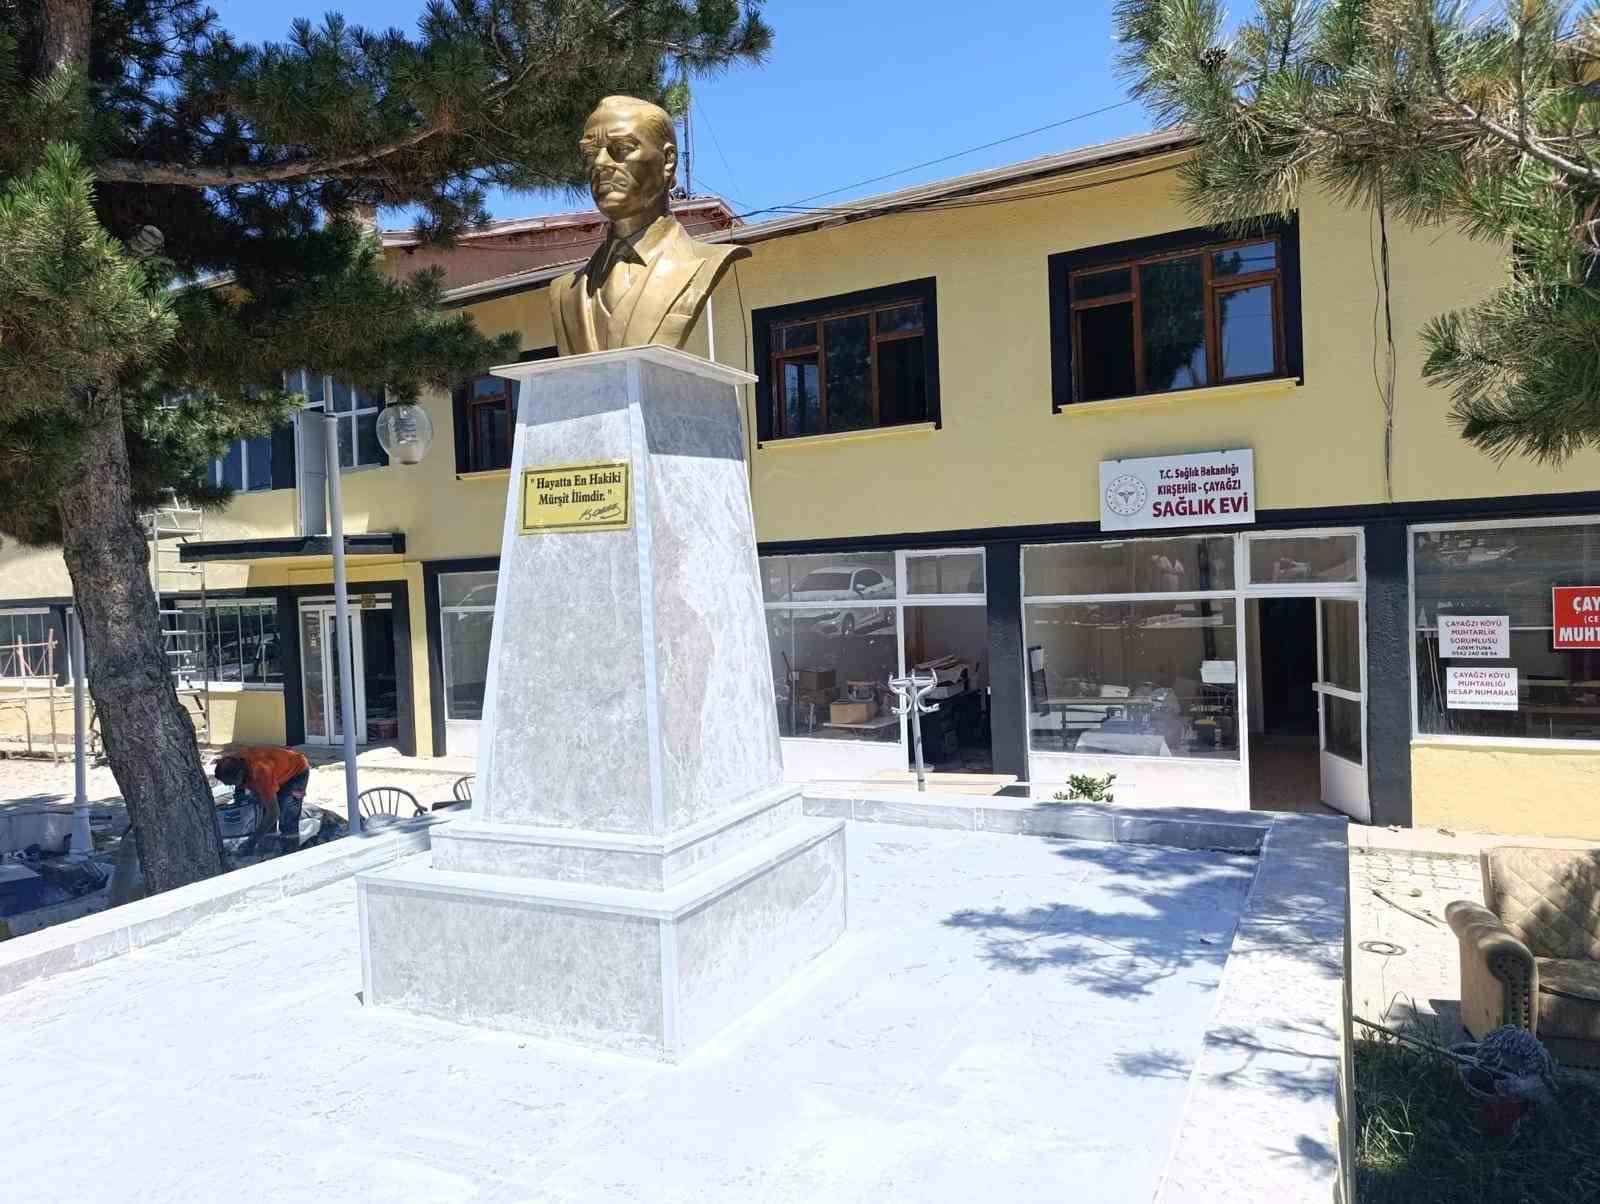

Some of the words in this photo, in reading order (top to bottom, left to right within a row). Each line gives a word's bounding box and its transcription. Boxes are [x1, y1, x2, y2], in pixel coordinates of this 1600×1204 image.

[574, 474, 587, 486] En
[589, 472, 621, 485] Hakiki
[1159, 469, 1173, 480] T.C.
[1175, 467, 1199, 480] Sağlık
[1200, 463, 1239, 478] Bakanlığı
[1157, 482, 1197, 497] KIRŞEHİR
[1203, 477, 1241, 494] ÇAYAĞZI
[538, 492, 569, 507] Mürşit
[1152, 496, 1216, 518] SAĞLIK
[1219, 492, 1249, 514] EVİ
